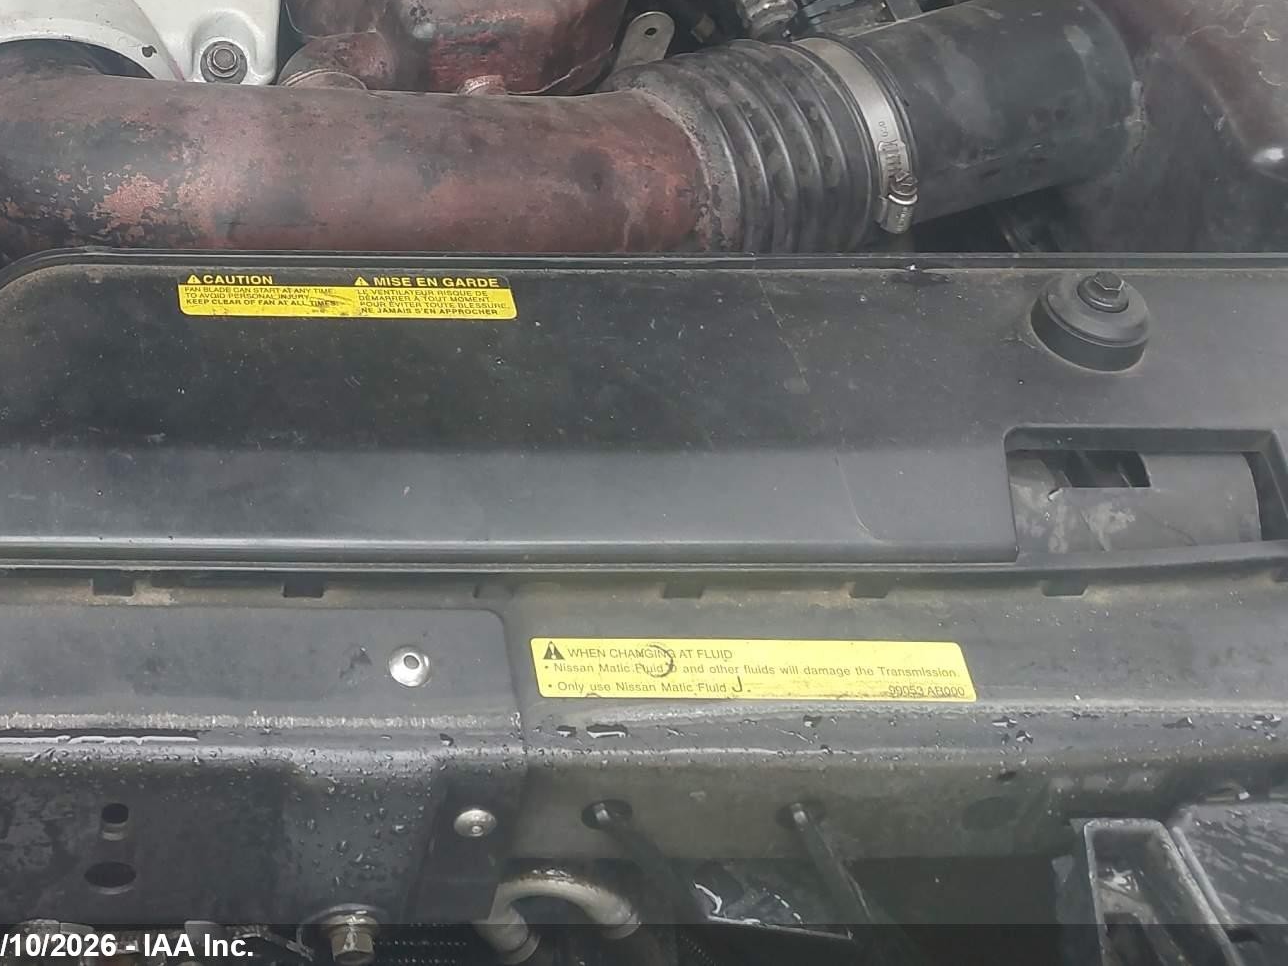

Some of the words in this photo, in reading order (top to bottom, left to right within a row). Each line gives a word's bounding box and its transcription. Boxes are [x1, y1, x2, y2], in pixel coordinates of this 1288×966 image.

[203, 275, 273, 285] CAUTION
[373, 277, 413, 287] MISE
[416, 277, 438, 287] EN
[442, 278, 500, 288] GARDE
[568, 649, 607, 659] WHEN
[609, 649, 677, 659] CHANGING
[679, 649, 694, 659] AT
[697, 649, 733, 659] FLUID
[553, 663, 595, 673] Nissan
[599, 664, 632, 673] Matic
[635, 664, 664, 674] Fluid
[682, 665, 706, 674] and
[708, 664, 739, 674] other
[744, 665, 776, 675] fluids
[780, 665, 800, 675] will
[803, 665, 852, 678] damage
[855, 665, 875, 675] the
[878, 665, 961, 677] Transmission.
[557, 682, 585, 694] Only
[590, 684, 611, 692] use
[616, 682, 657, 693] Nissan
[661, 683, 692, 693] Matic
[697, 682, 728, 693] Fluid
